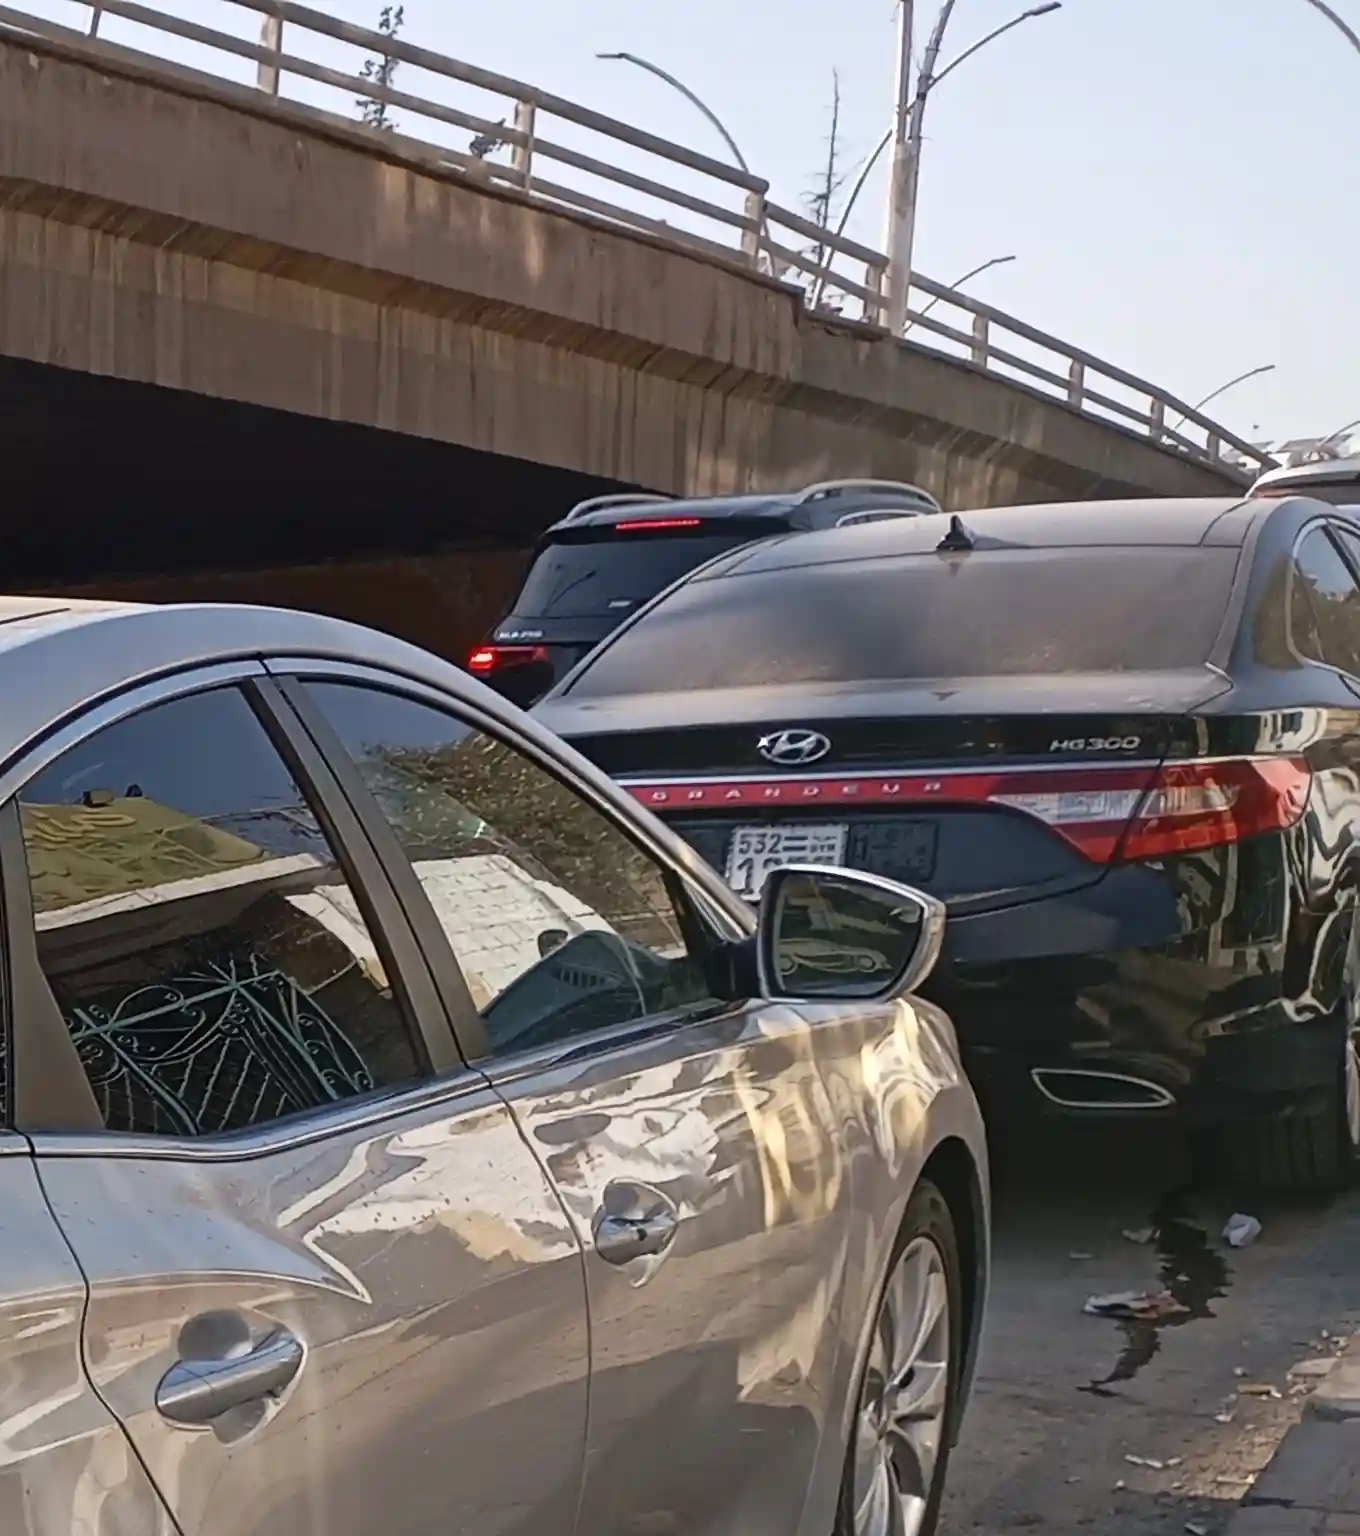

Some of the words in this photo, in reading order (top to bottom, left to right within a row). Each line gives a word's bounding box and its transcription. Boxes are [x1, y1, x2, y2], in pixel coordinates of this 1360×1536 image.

[1049, 735, 1141, 752] HG300
[651, 782, 942, 801] GRANDEUR
[738, 832, 782, 854] 532
